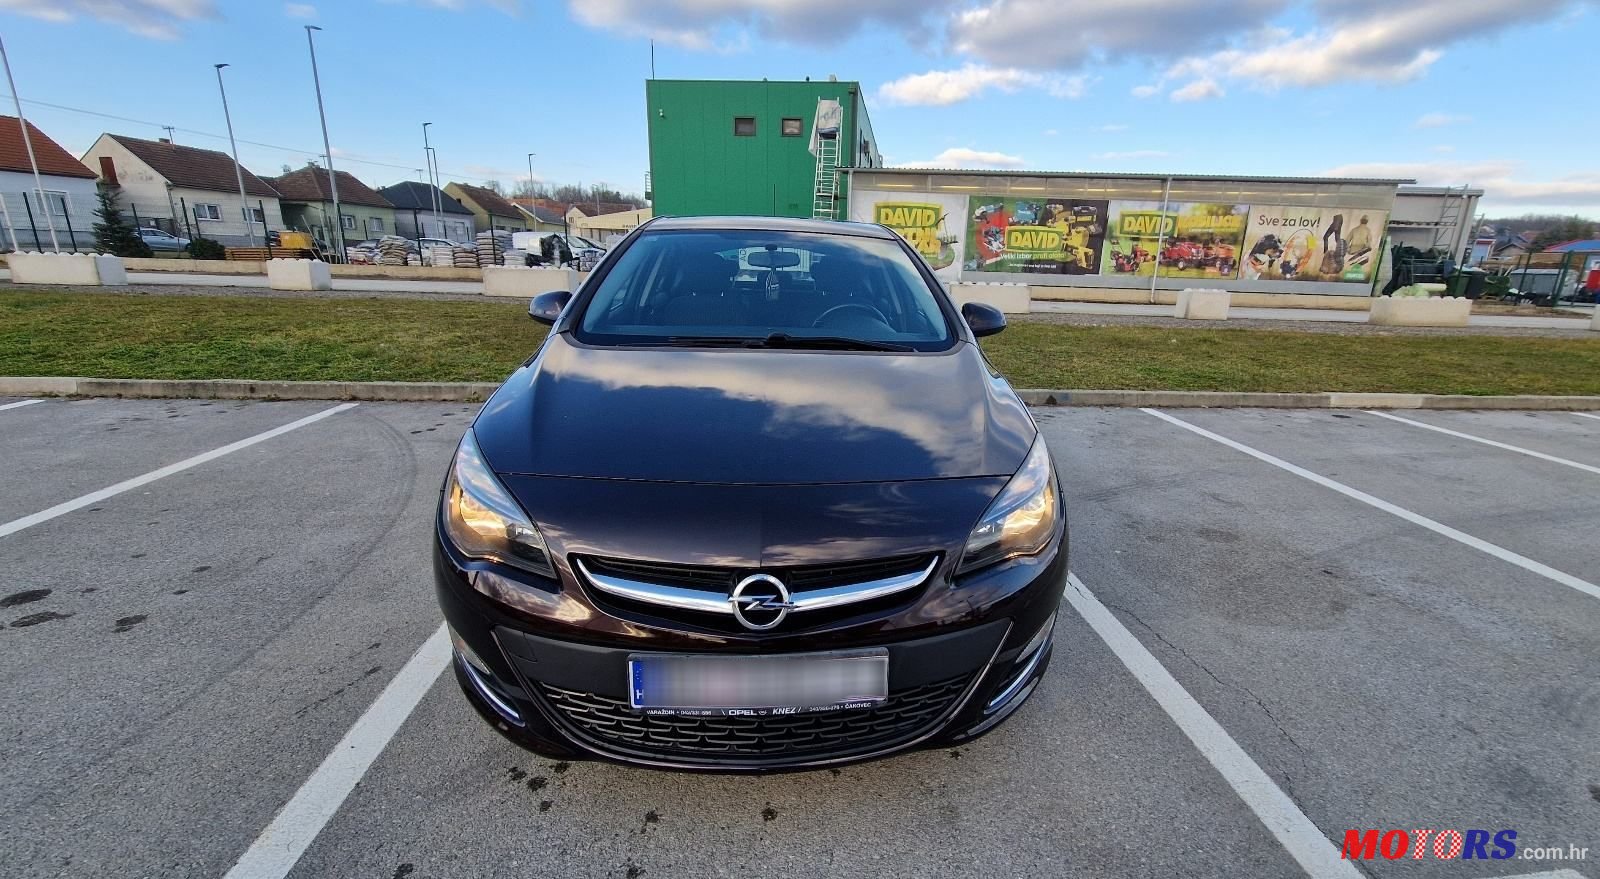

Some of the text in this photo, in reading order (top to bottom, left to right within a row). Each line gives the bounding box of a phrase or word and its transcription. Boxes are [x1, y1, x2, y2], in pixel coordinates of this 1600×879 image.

[880, 207, 936, 226] DAVID
[1123, 215, 1174, 234] DAVID
[1258, 215, 1320, 228] Sve za lov!
[1010, 231, 1060, 249] DAVID
[772, 707, 796, 715] KNEZ
